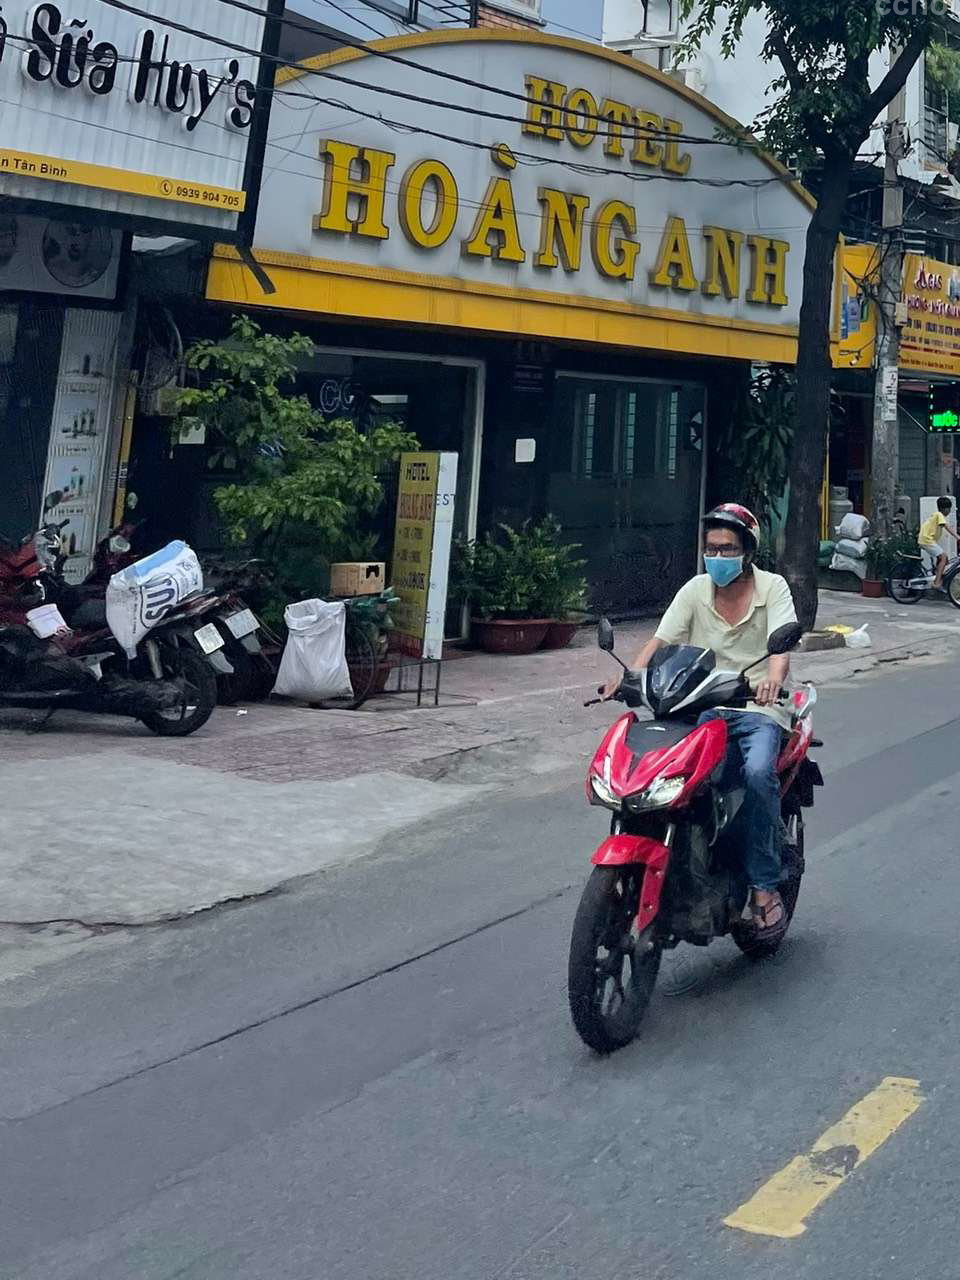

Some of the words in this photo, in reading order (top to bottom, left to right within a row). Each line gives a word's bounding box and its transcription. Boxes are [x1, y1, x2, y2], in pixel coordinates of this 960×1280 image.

[22, 3, 118, 95] Sữa
[130, 29, 256, 131] Huy's
[521, 74, 692, 176] HOTEL
[175, 185, 200, 199] 0939
[202, 191, 219, 202] 904
[222, 194, 240, 206] 705
[312, 138, 640, 281] HOÀNG
[649, 215, 790, 306] ANH
